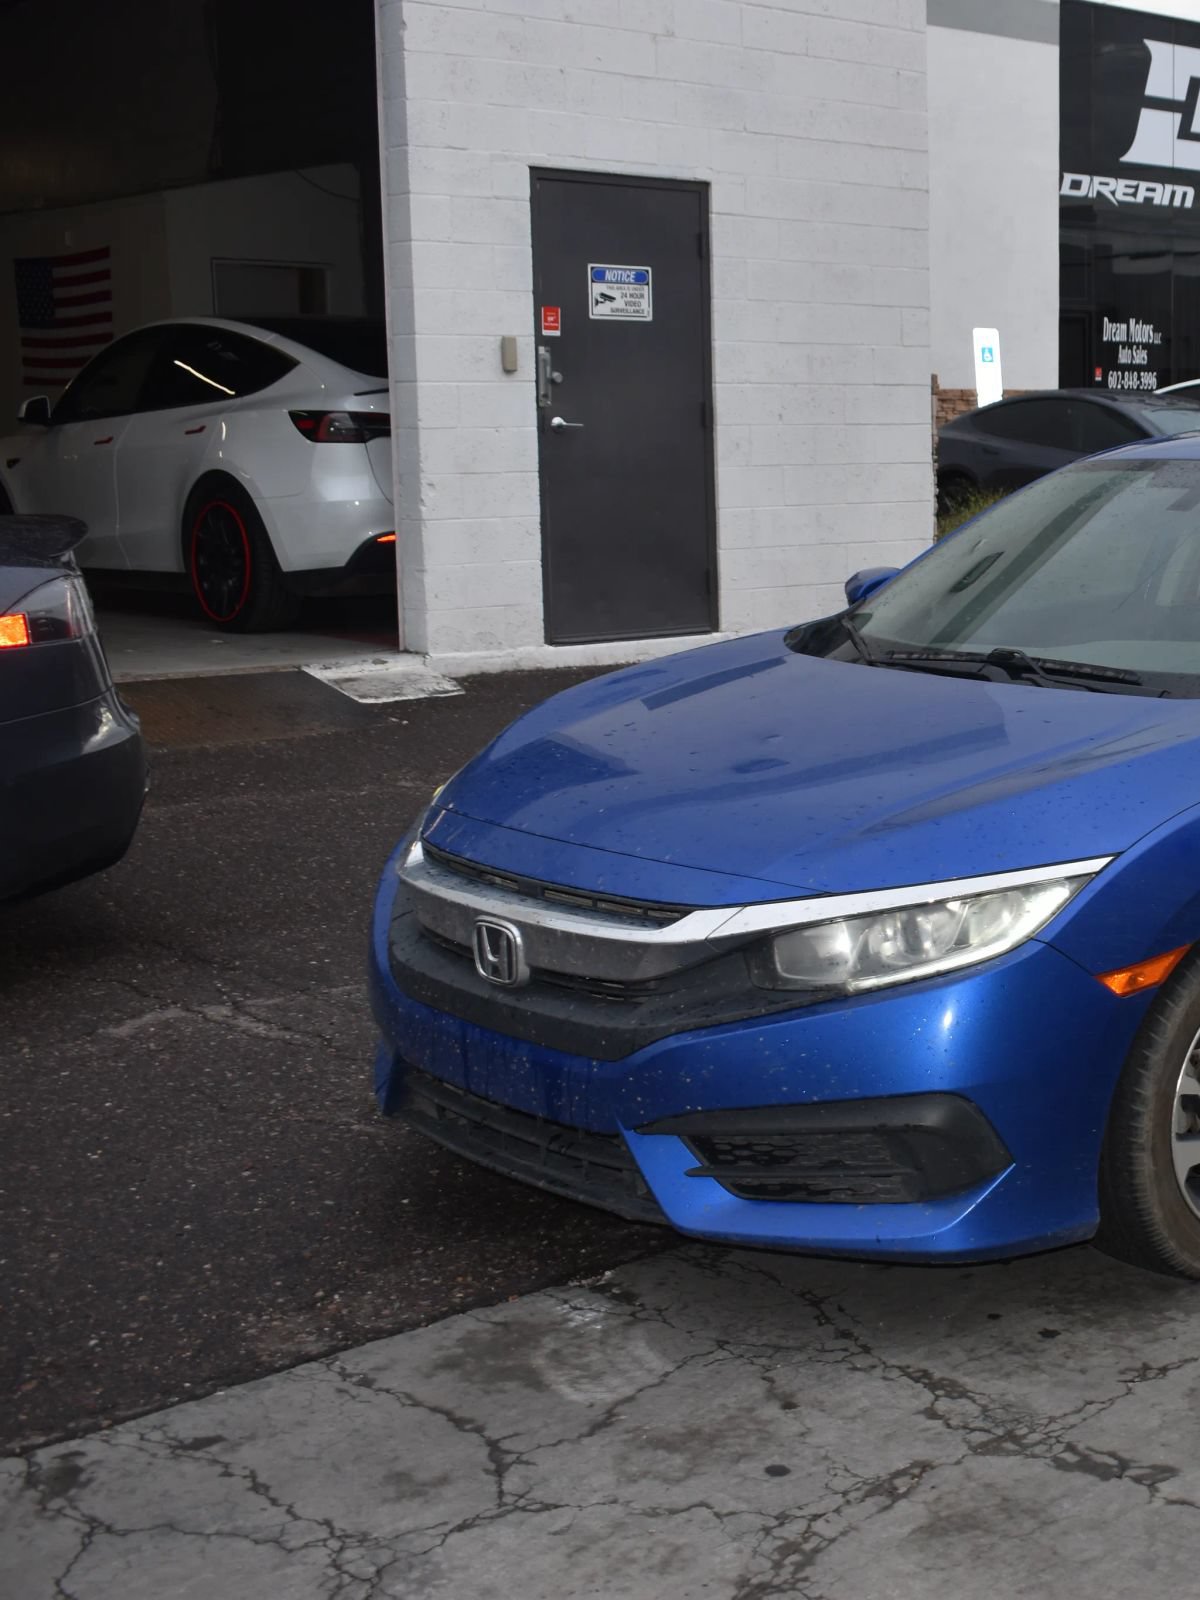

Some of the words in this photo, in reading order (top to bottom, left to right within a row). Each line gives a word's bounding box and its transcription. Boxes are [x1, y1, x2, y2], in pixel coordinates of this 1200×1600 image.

[1059, 172, 1195, 208] DREAM
[605, 270, 636, 282] NOTICE
[1103, 316, 1127, 342] Dream
[1129, 318, 1154, 344] Motors
[1118, 345, 1132, 364] Auto
[1132, 345, 1148, 365] Sales
[1108, 371, 1157, 390] 602-848-3996
